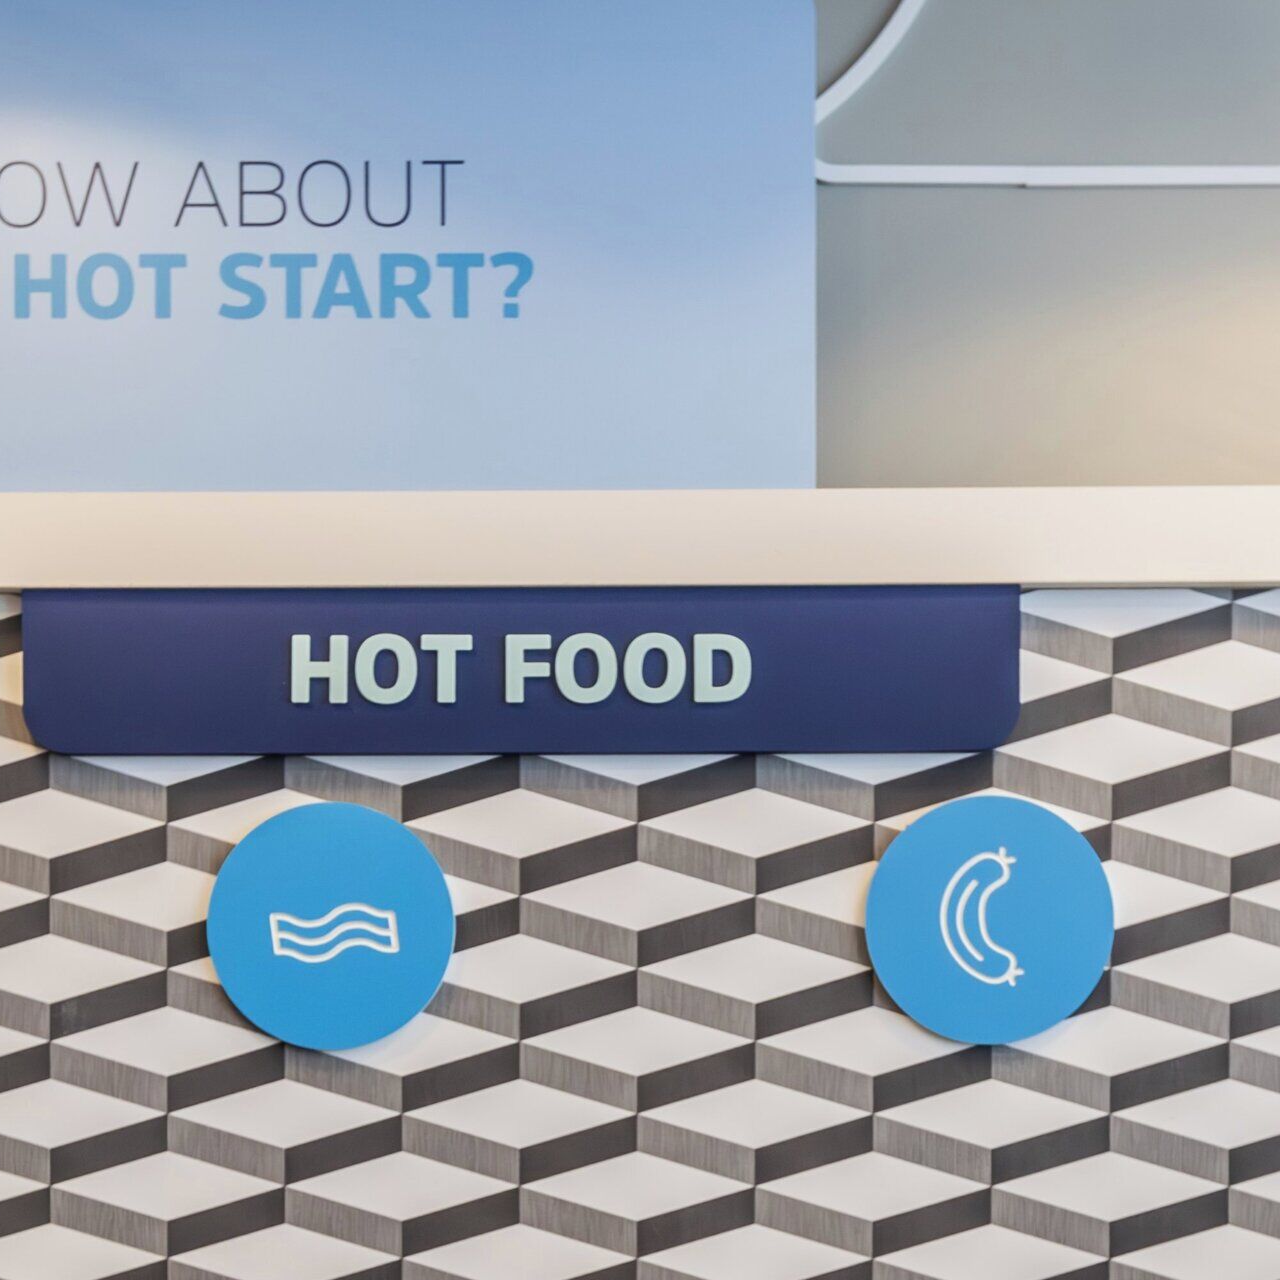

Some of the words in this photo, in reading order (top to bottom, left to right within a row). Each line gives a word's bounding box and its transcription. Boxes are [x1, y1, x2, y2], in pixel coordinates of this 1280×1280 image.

[174, 159, 465, 228] ABOUT
[13, 252, 188, 321] HOT
[218, 251, 535, 320] START?
[290, 632, 474, 705] HOT
[505, 632, 752, 705] FOOD
